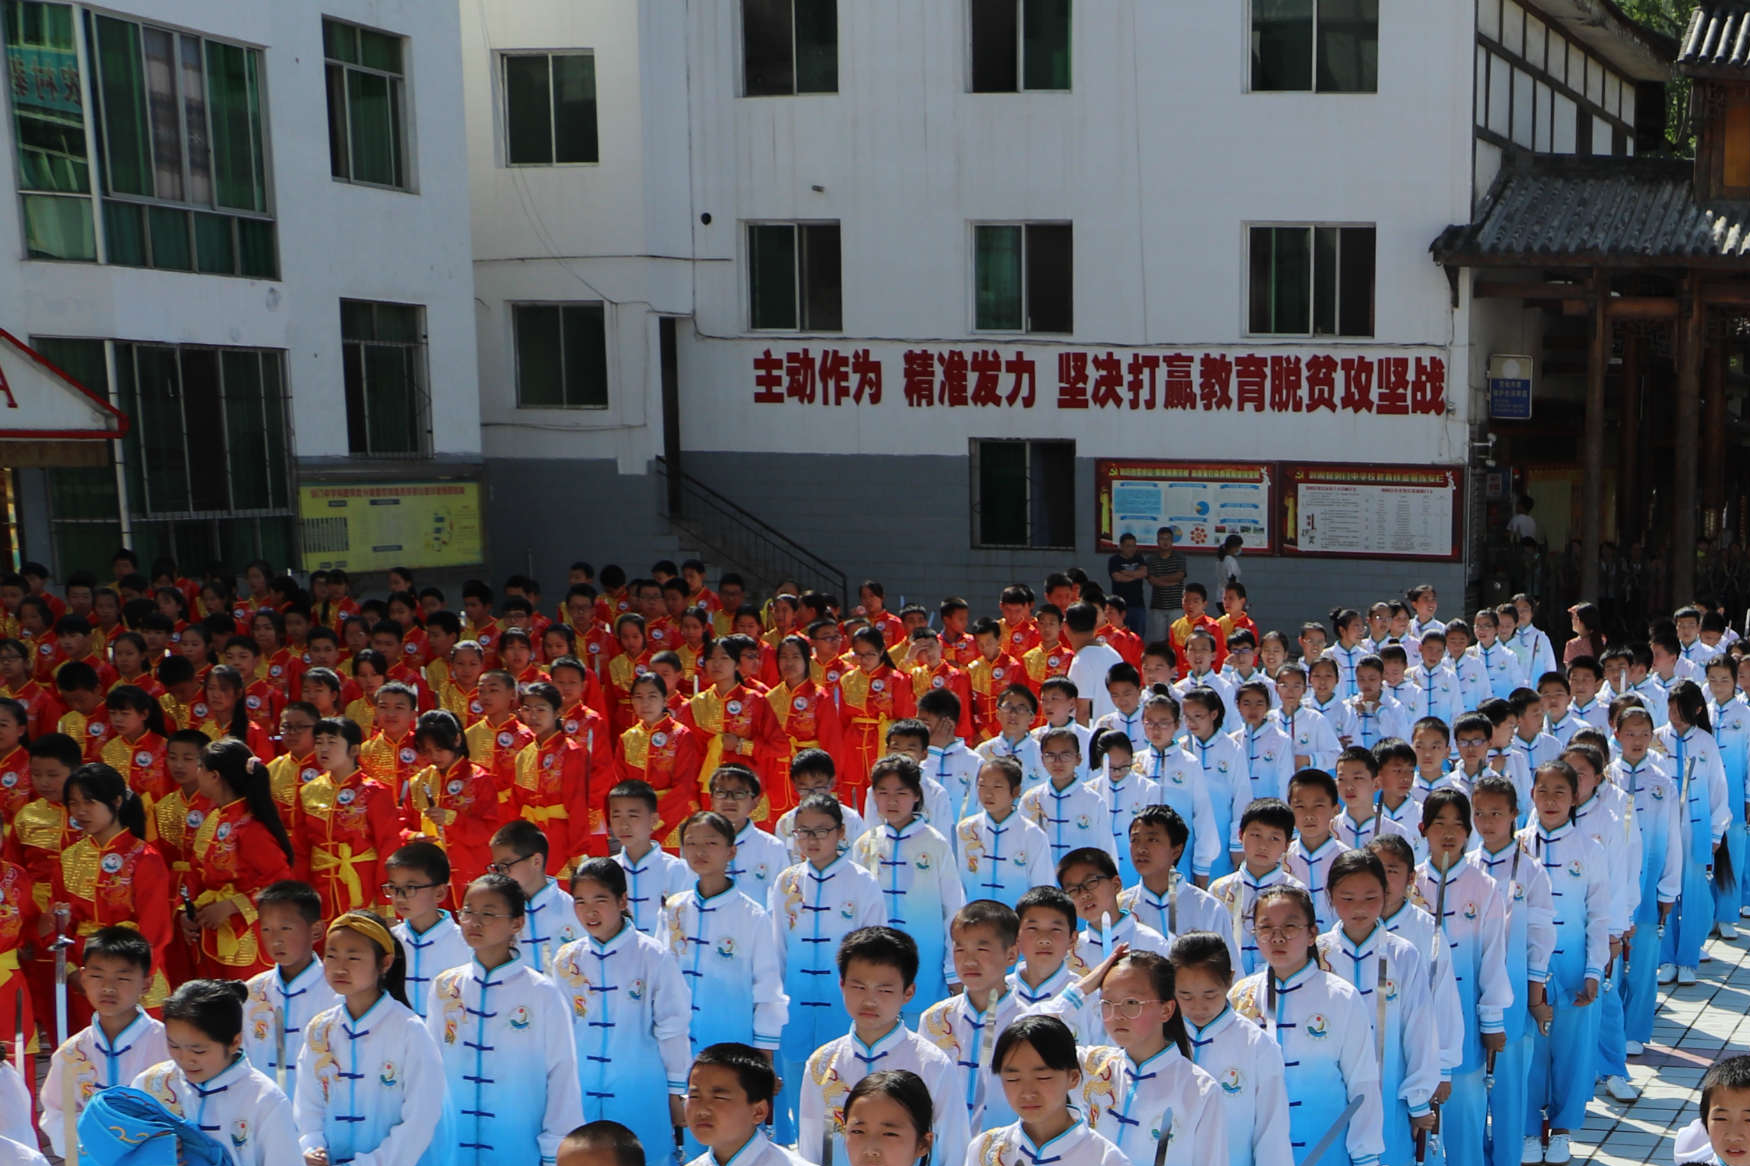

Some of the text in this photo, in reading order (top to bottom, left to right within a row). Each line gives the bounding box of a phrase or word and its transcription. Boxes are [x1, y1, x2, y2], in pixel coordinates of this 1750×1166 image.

[753, 348, 883, 406] 主动作为
[903, 349, 1037, 408] 精准发力
[1057, 351, 1445, 416] 坚决打赢教育脱贫攻坚战
